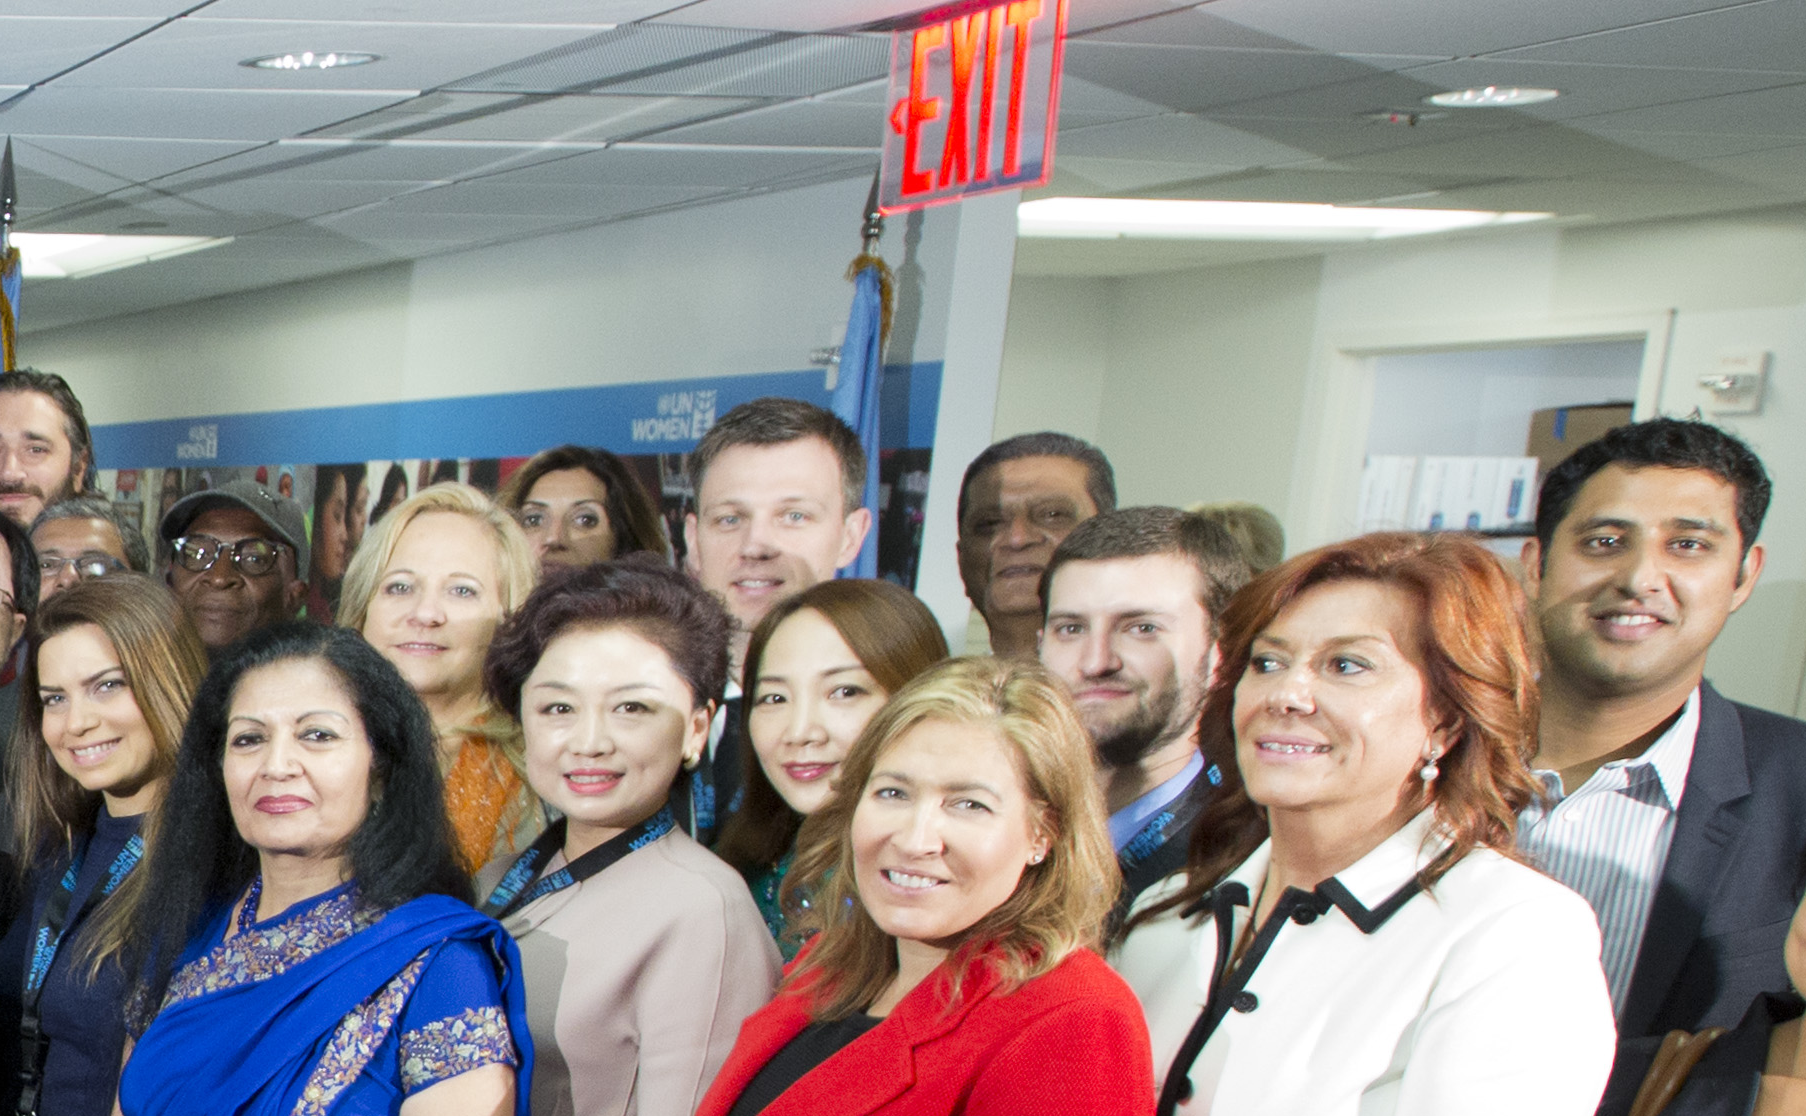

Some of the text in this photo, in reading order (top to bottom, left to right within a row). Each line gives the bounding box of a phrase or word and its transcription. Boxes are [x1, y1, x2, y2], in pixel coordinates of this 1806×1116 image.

[900, 0, 1044, 197] EXIT
[632, 417, 691, 441] WOMEN
[102, 855, 138, 895] WOMEN
[116, 849, 132, 866] UN
[32, 927, 49, 973] WOMEN
